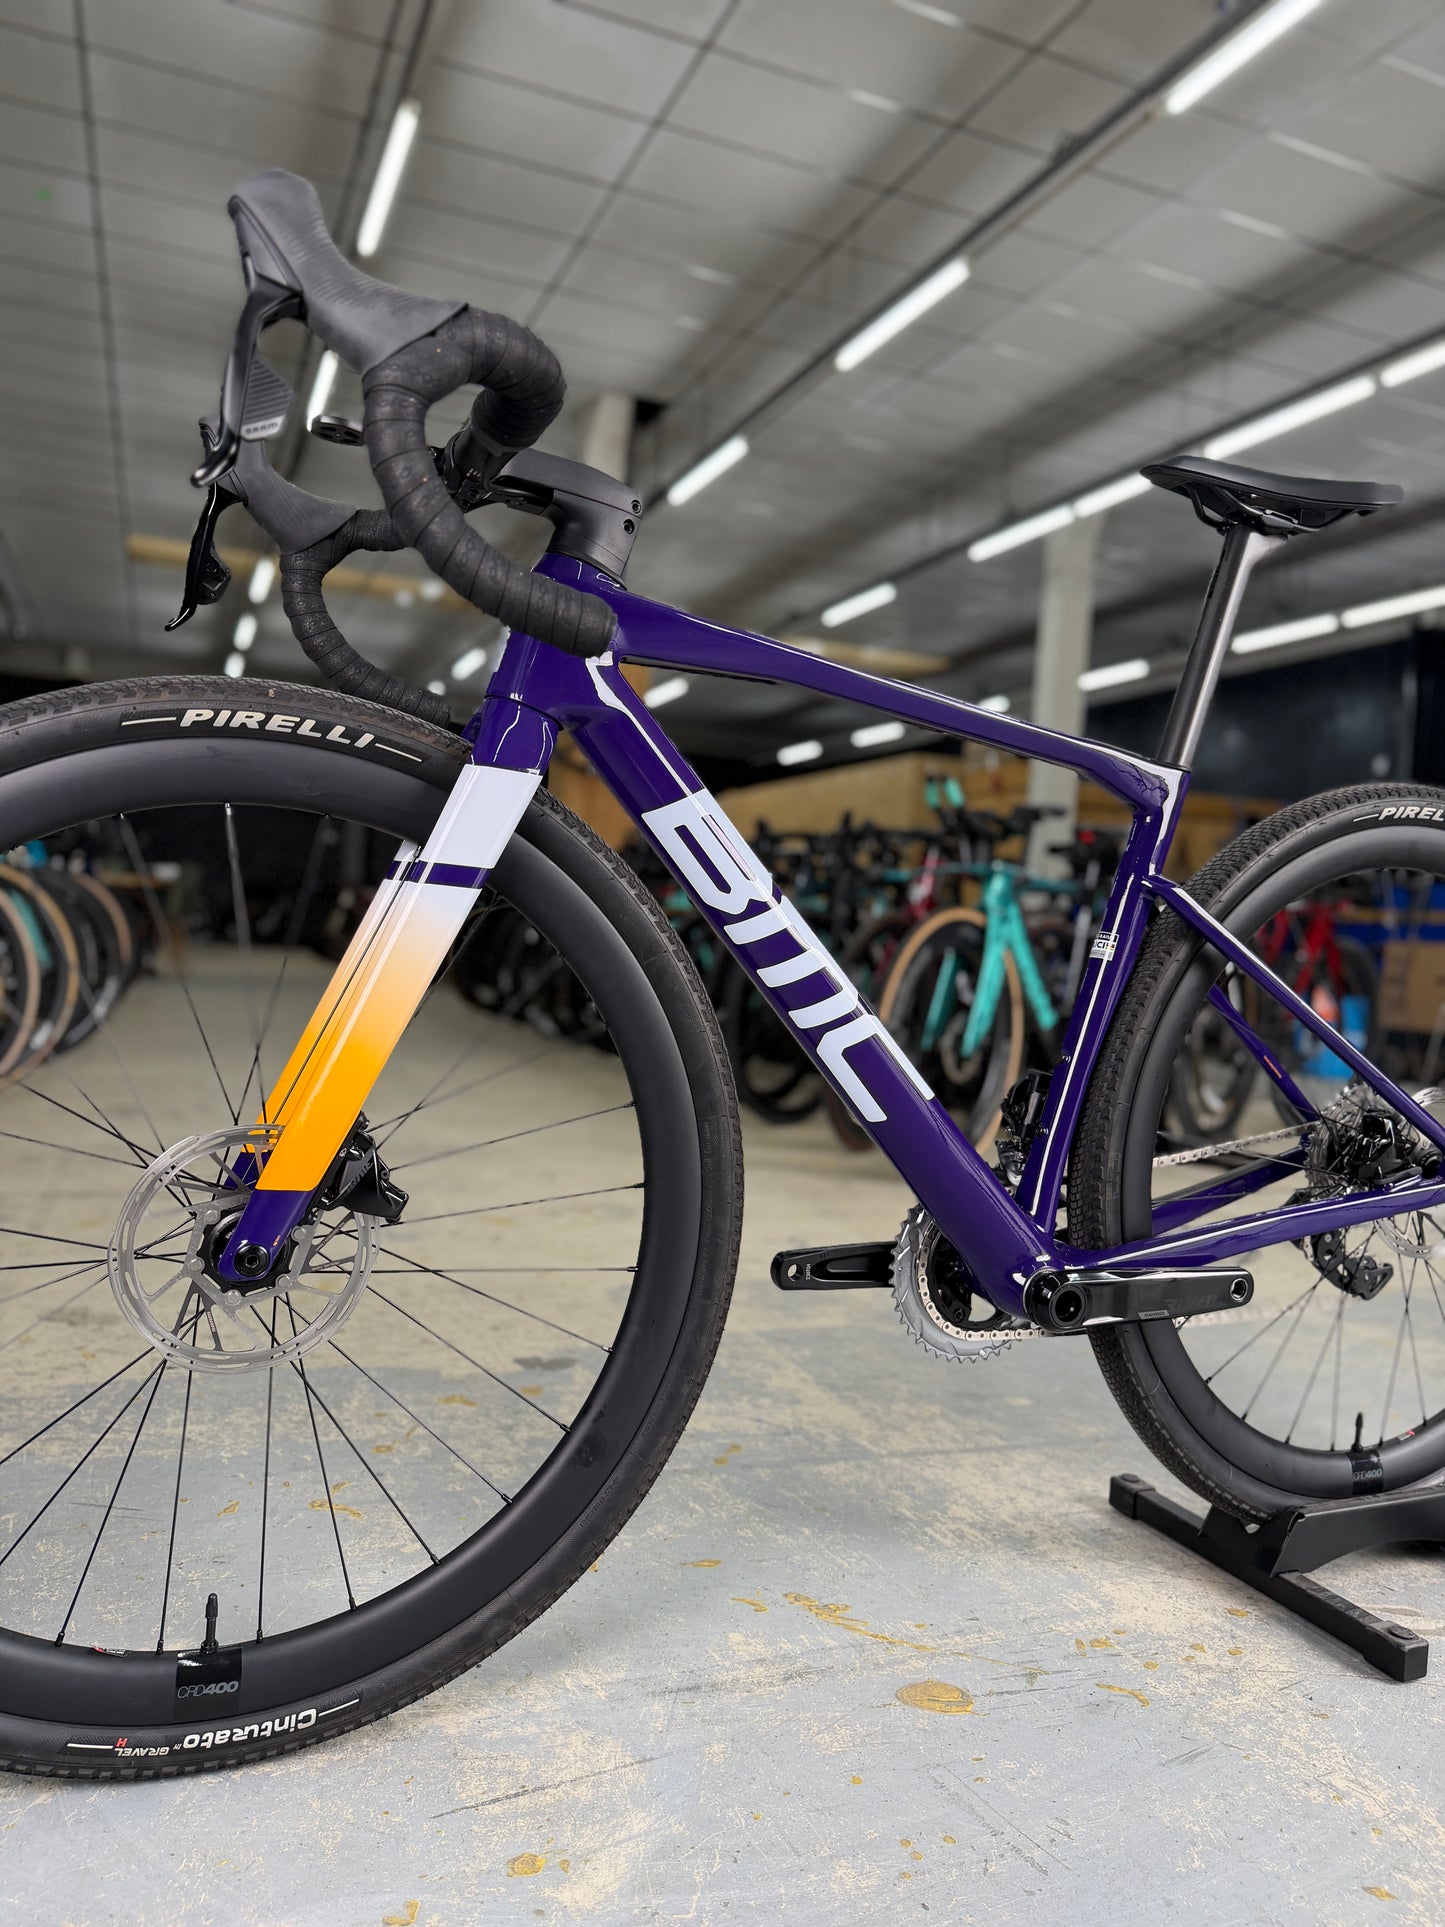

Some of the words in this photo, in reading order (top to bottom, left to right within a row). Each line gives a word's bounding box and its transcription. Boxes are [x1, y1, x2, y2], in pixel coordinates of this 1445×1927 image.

[179, 709, 375, 748] PIRELLI
[177, 1680, 239, 1699] CRD400
[182, 1708, 317, 1749] Cinturato
[114, 1747, 170, 1757] GRAVEL
[116, 1737, 128, 1748] H
